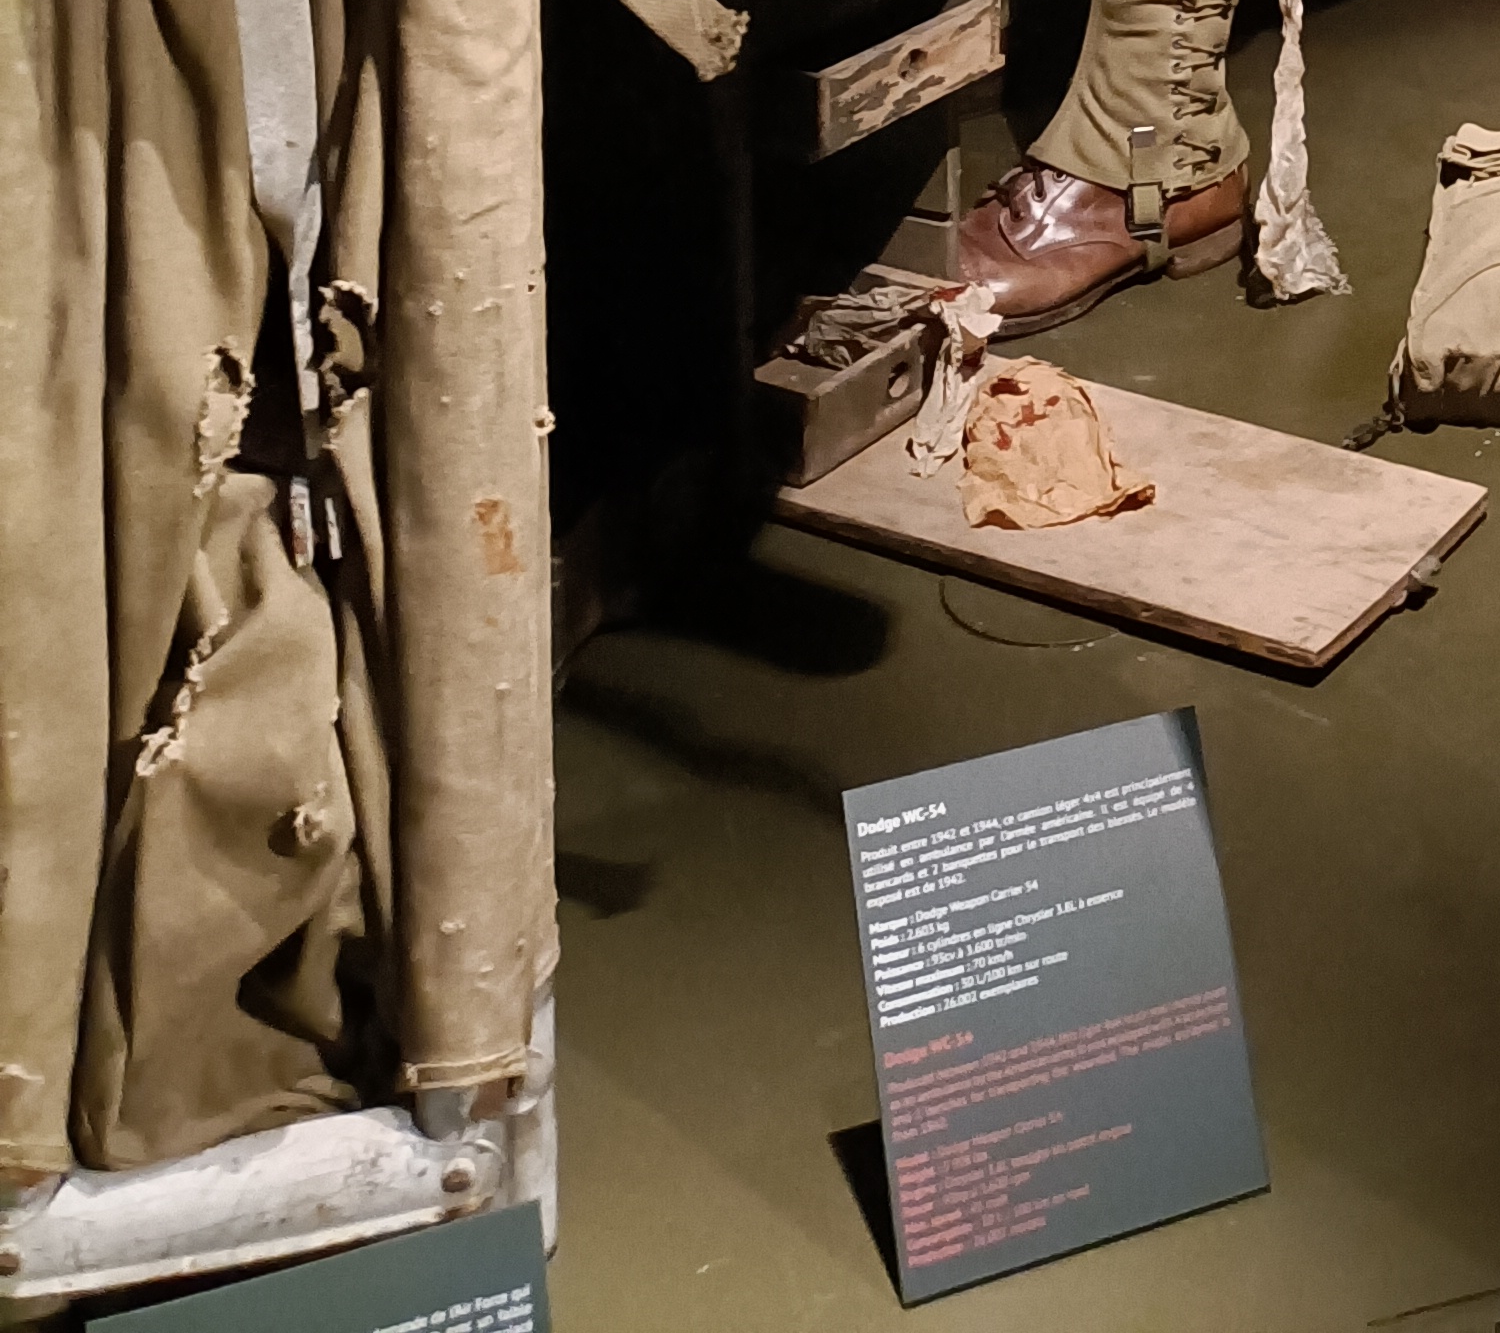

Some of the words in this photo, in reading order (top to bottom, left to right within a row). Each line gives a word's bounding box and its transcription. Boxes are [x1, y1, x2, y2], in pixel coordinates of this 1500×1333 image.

[857, 817, 900, 837] Dodge
[902, 802, 946, 824] WC-54
[861, 845, 898, 862] Produit
[931, 828, 956, 844] 1942
[972, 819, 1001, 833] 1944,
[1056, 798, 1079, 811] léger
[915, 907, 948, 922] Dodge
